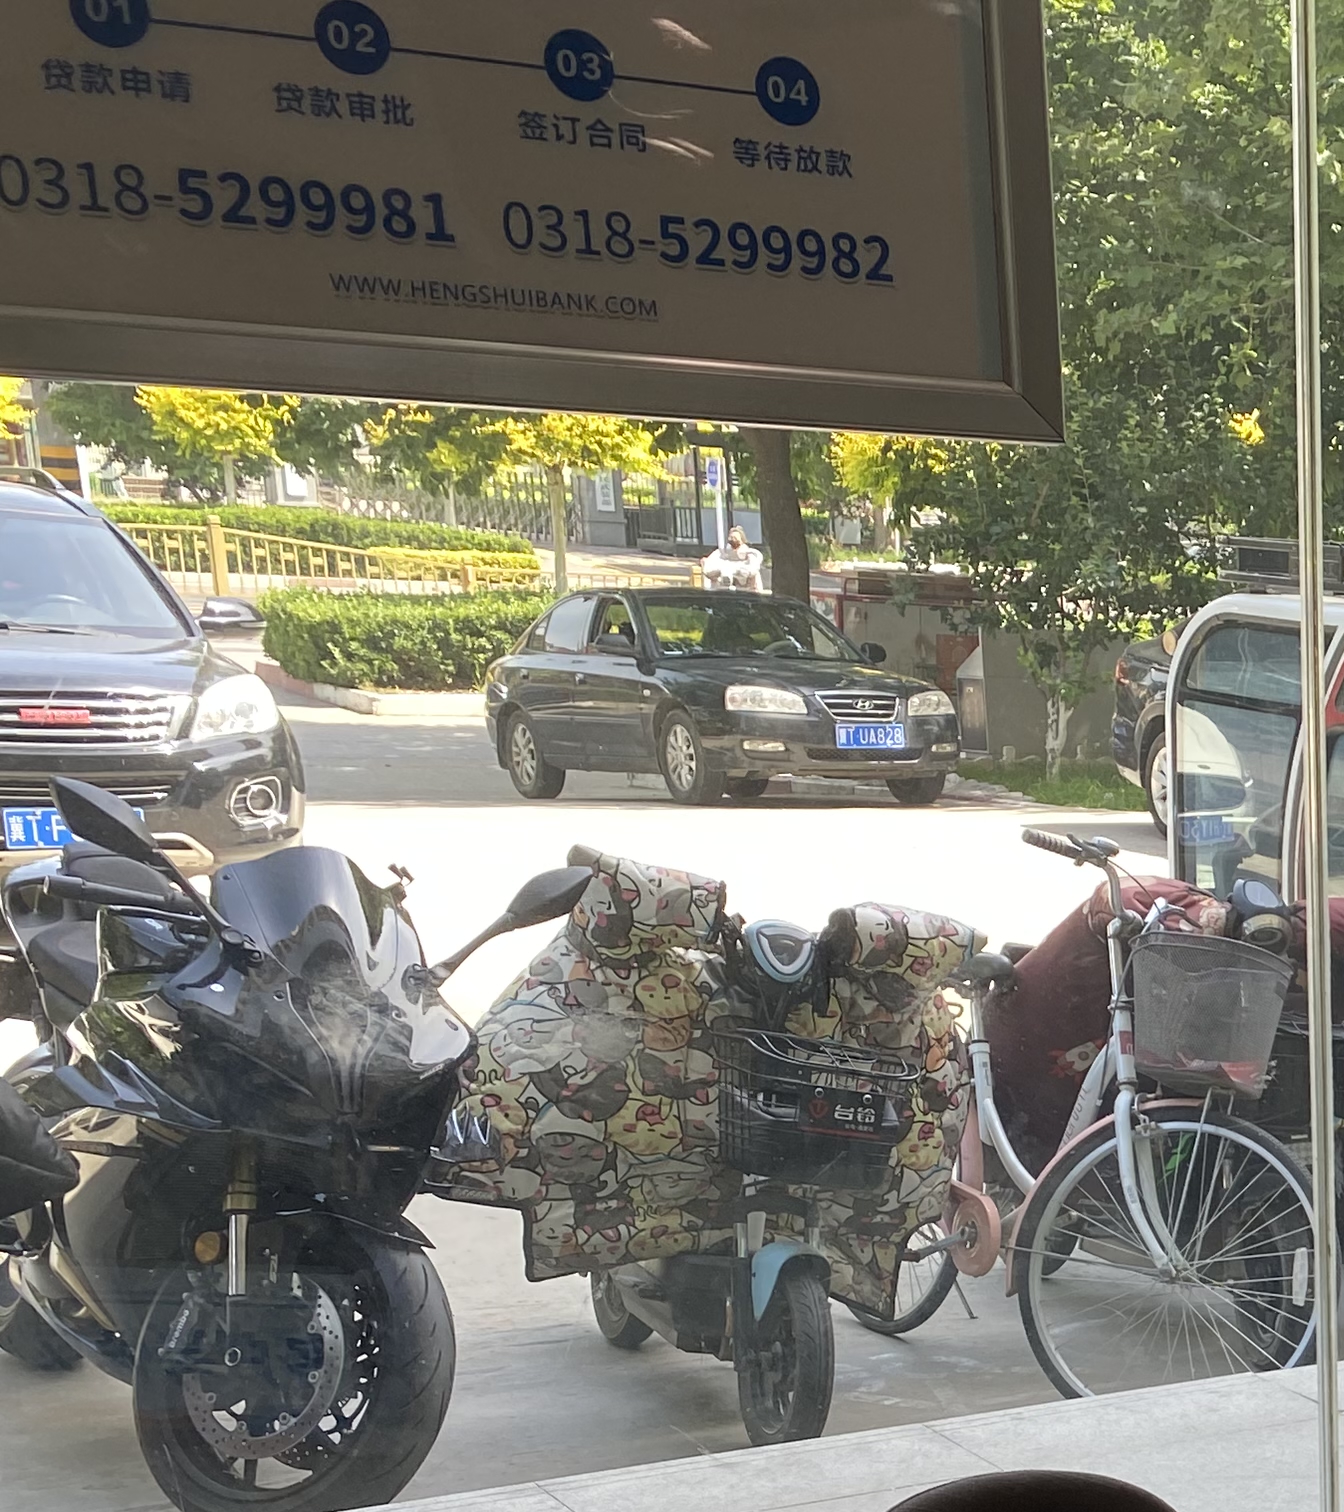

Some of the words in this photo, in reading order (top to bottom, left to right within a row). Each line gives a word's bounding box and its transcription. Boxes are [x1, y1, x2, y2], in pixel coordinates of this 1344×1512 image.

[326, 19, 377, 53] 02
[41, 58, 192, 103] 贷款申请
[556, 49, 602, 81] 03
[273, 82, 415, 127] 贷款审批
[766, 75, 809, 106] 04
[517, 109, 647, 153] 签订合同
[732, 137, 853, 178] 等待放款
[0, 154, 456, 245] 0318-5299981
[503, 201, 895, 284] 0318-5299982
[329, 272, 658, 318] WWW.HENGSHUIBANK.COM
[834, 1104, 876, 1124] 台铃
